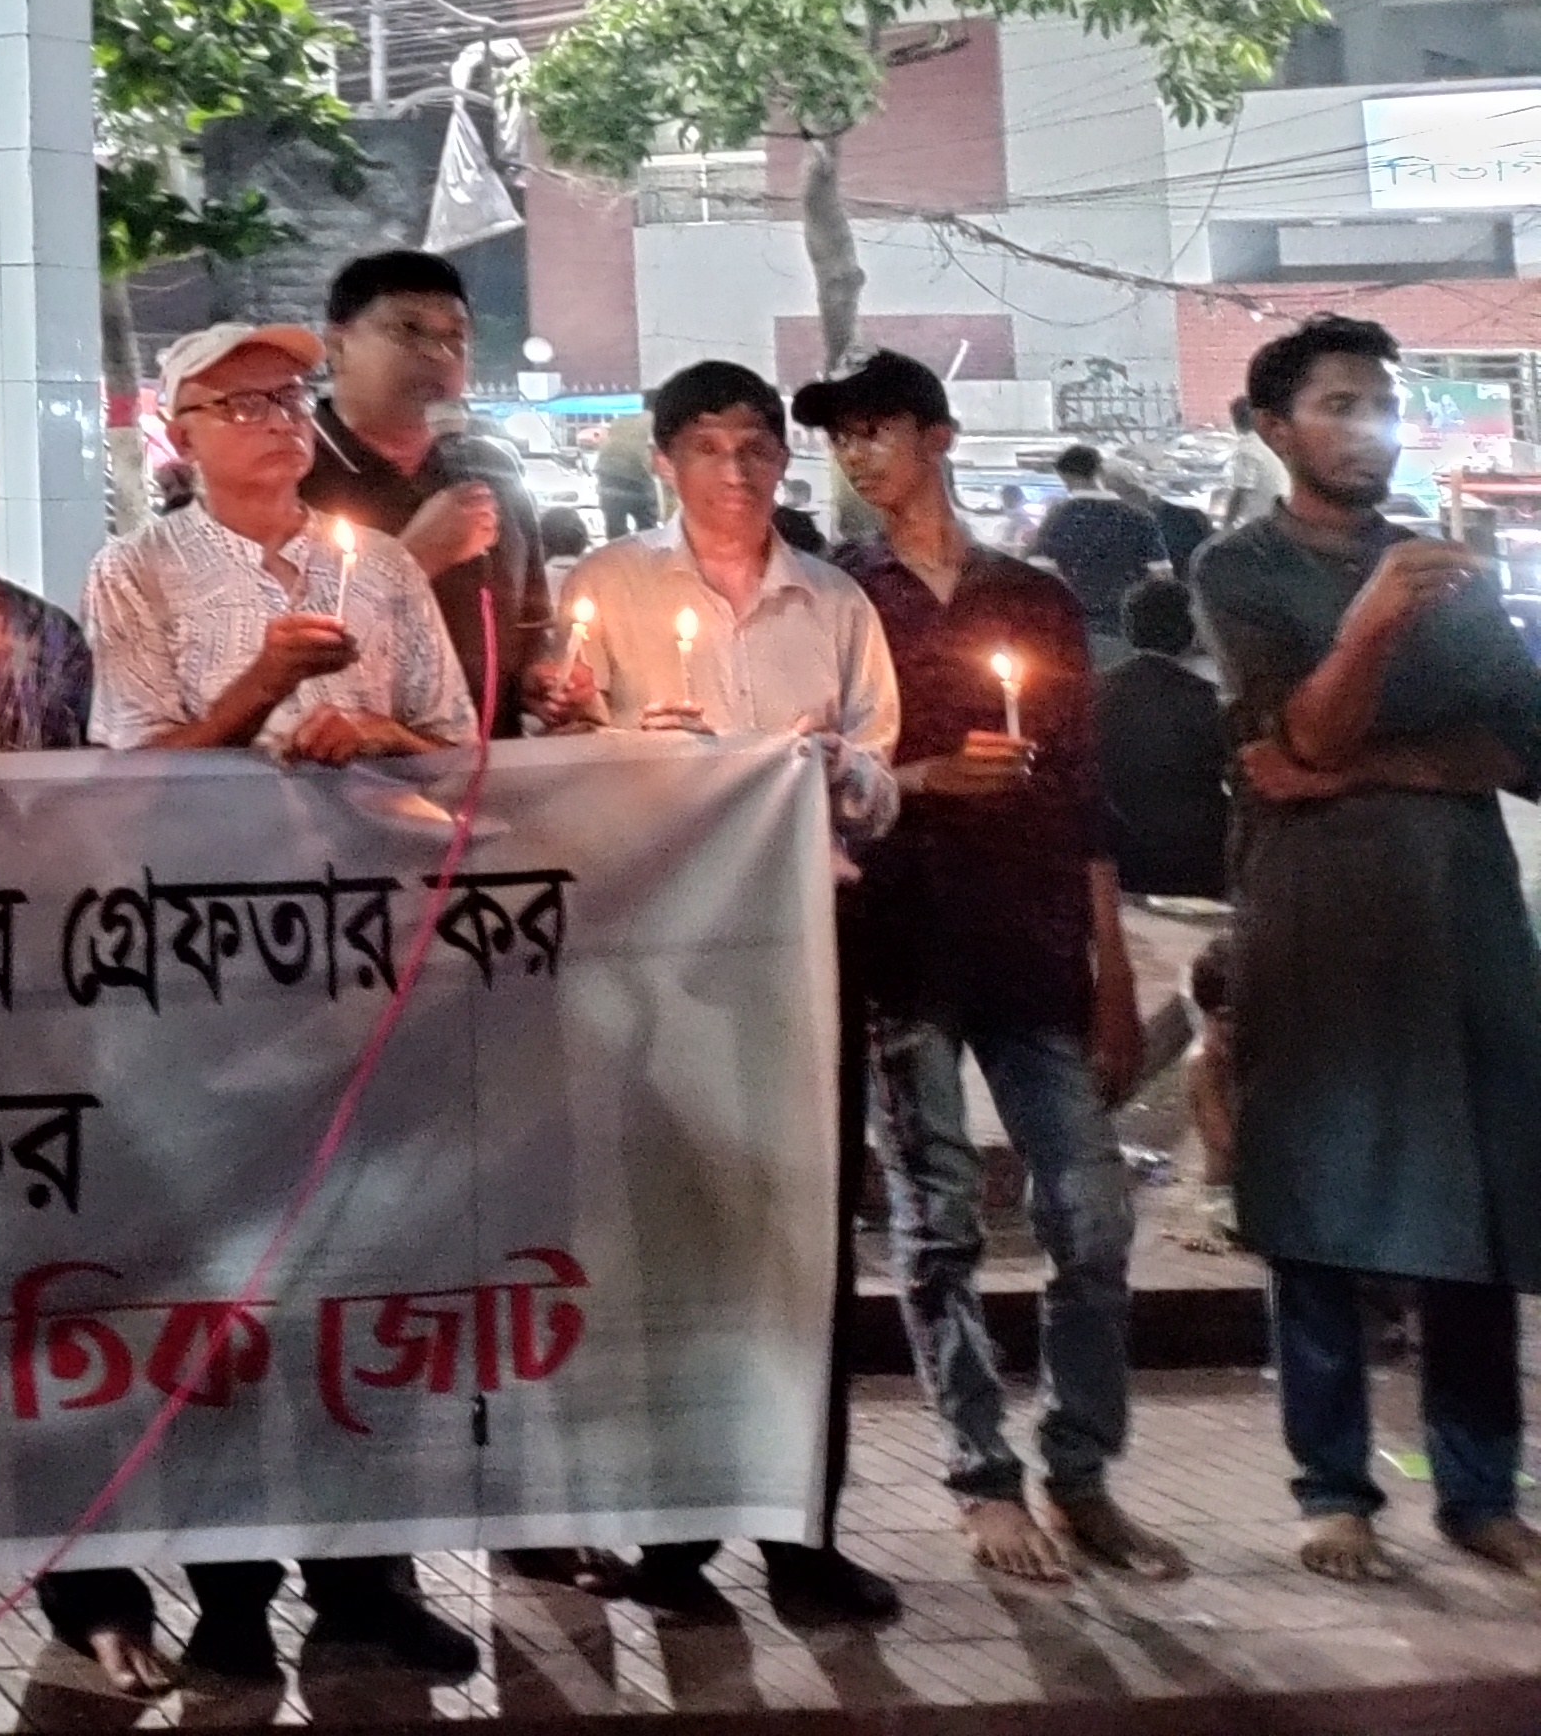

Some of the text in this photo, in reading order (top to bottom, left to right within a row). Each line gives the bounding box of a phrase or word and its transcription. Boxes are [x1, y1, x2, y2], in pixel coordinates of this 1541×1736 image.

[61, 862, 404, 1014] গ্রেফতার
[423, 868, 575, 992] কর
[319, 1248, 590, 1436] জোট
